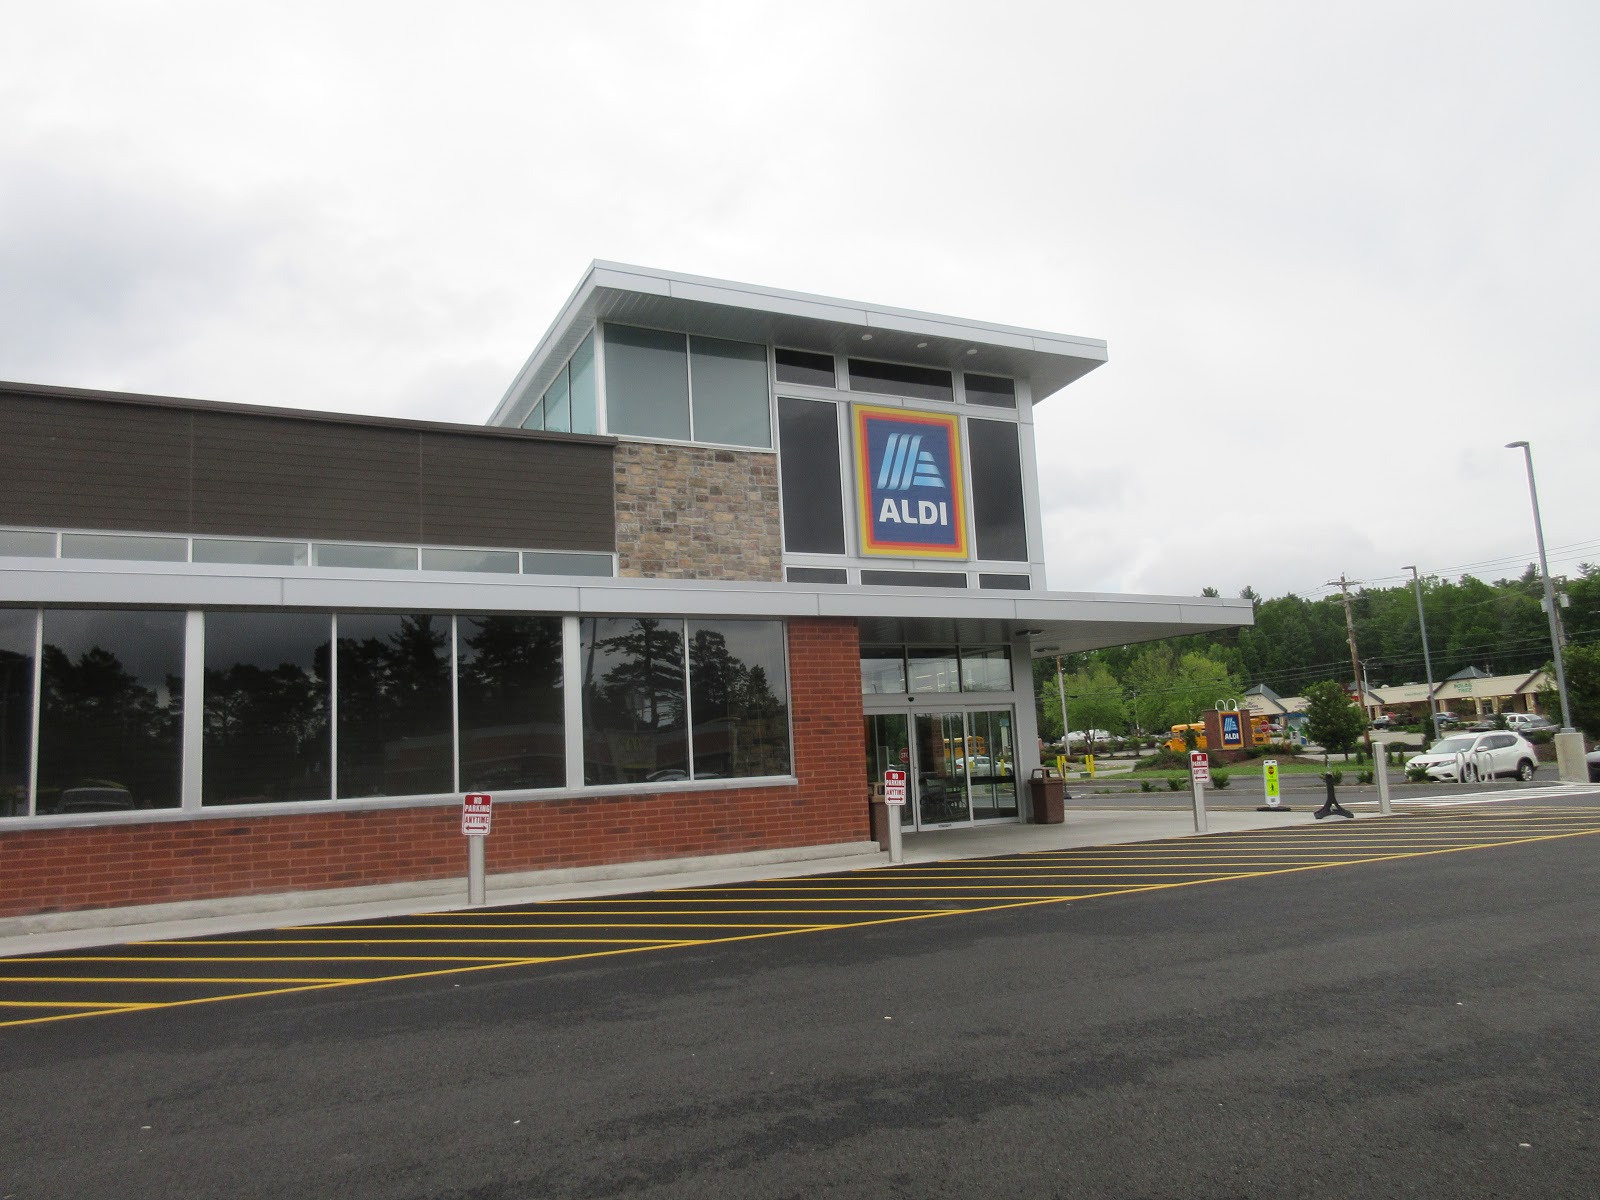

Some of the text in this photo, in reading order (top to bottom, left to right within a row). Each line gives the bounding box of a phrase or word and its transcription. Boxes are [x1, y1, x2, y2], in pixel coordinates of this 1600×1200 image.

[879, 498, 948, 526] ALDI
[1224, 732, 1240, 740] ALDI
[473, 796, 482, 804] NO
[465, 804, 490, 812] PARKING
